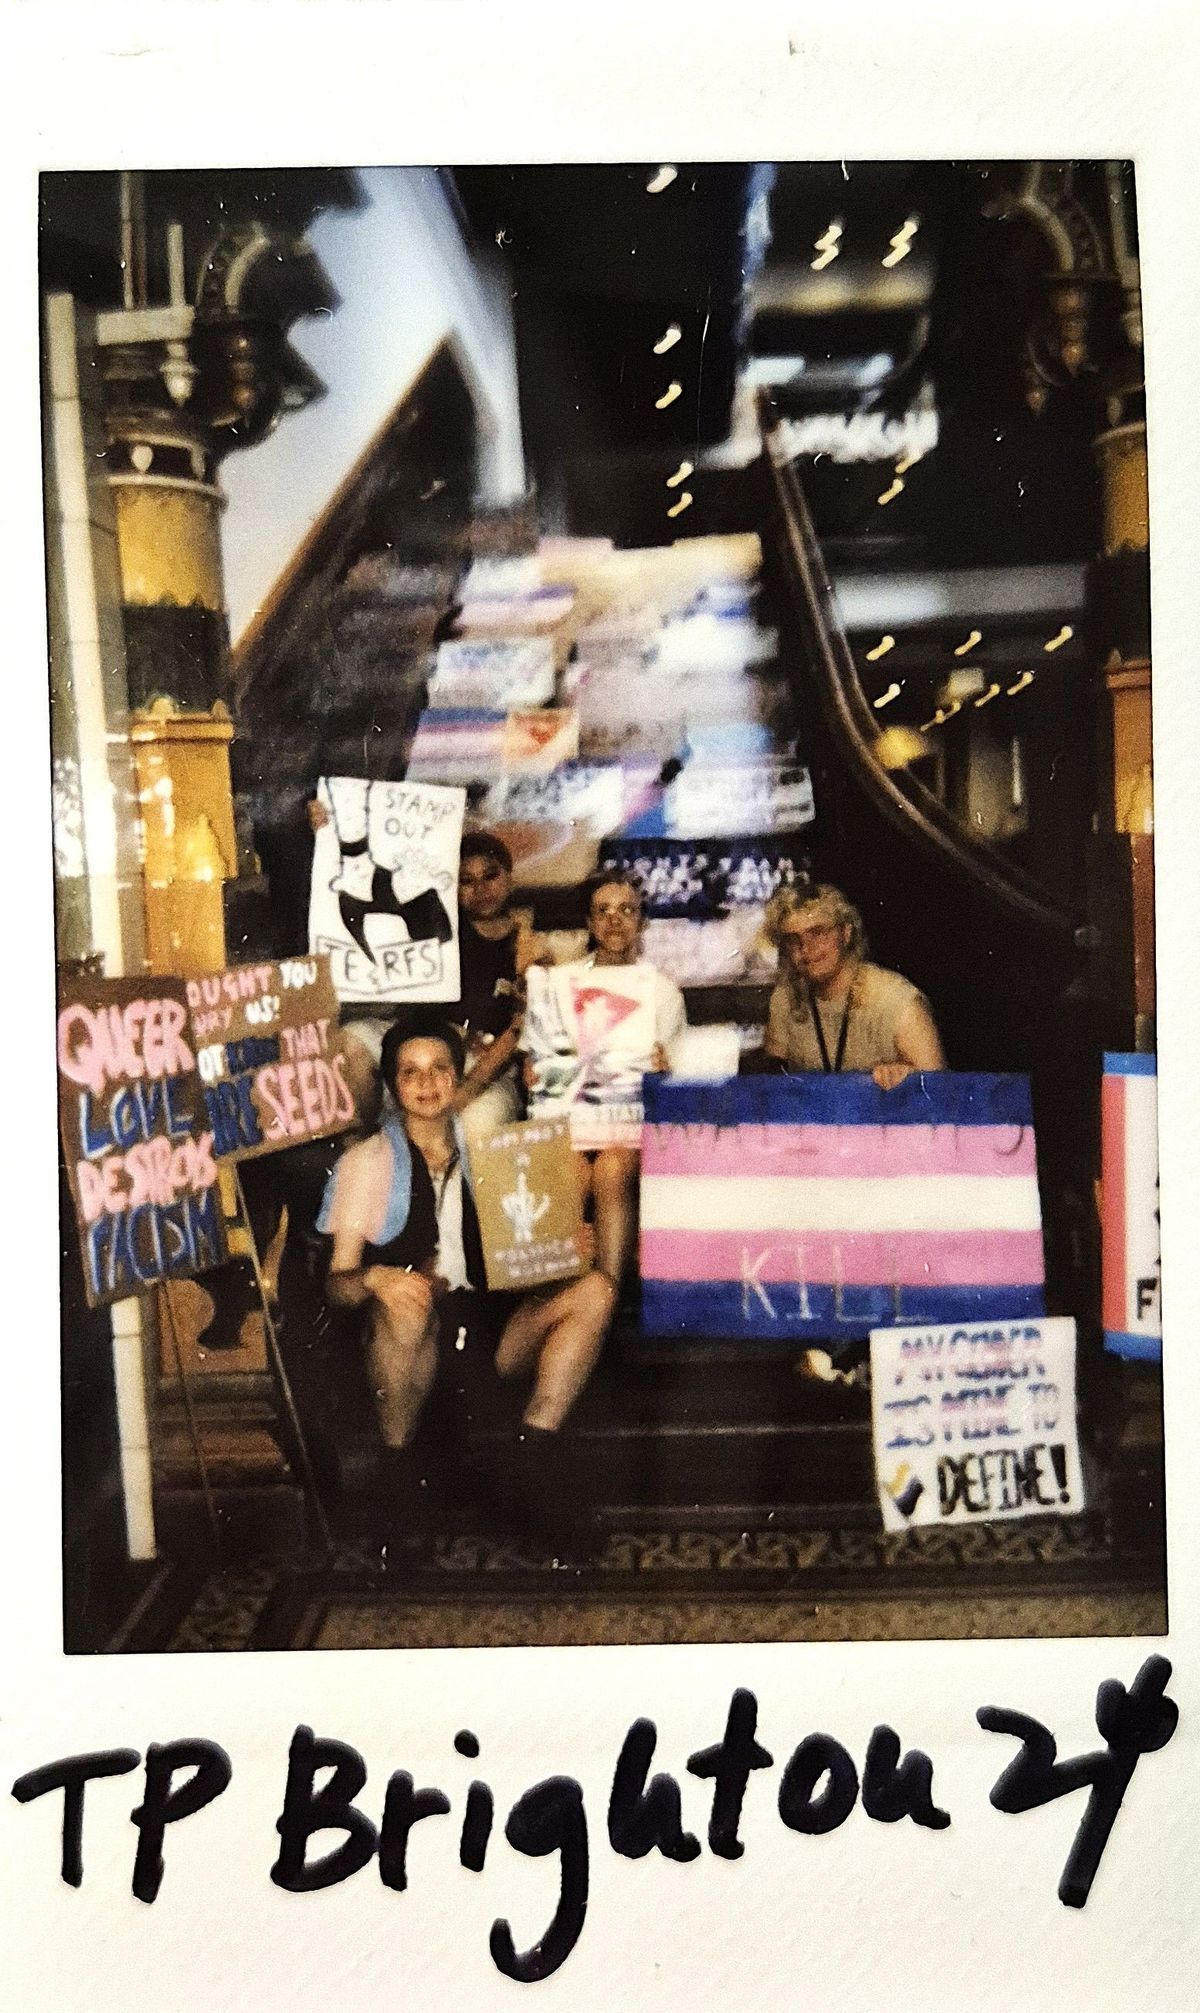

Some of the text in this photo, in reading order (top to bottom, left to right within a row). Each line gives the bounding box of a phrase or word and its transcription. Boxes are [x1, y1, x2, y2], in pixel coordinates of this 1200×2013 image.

[385, 788, 458, 821] STAMP
[385, 818, 434, 840] OUT
[279, 960, 318, 990] YOU
[324, 943, 437, 984] TERFS
[57, 998, 196, 1098] QUEER
[281, 1018, 332, 1058] THAT
[79, 1078, 194, 1160] LOVE
[256, 1053, 356, 1141] SEEDS
[87, 1190, 226, 1295] RACISM
[740, 1245, 936, 1326] KILL
[936, 1443, 1071, 1516] DEFINE!
[11, 1735, 233, 1904] TP
[269, 1687, 951, 1983] Brighton
